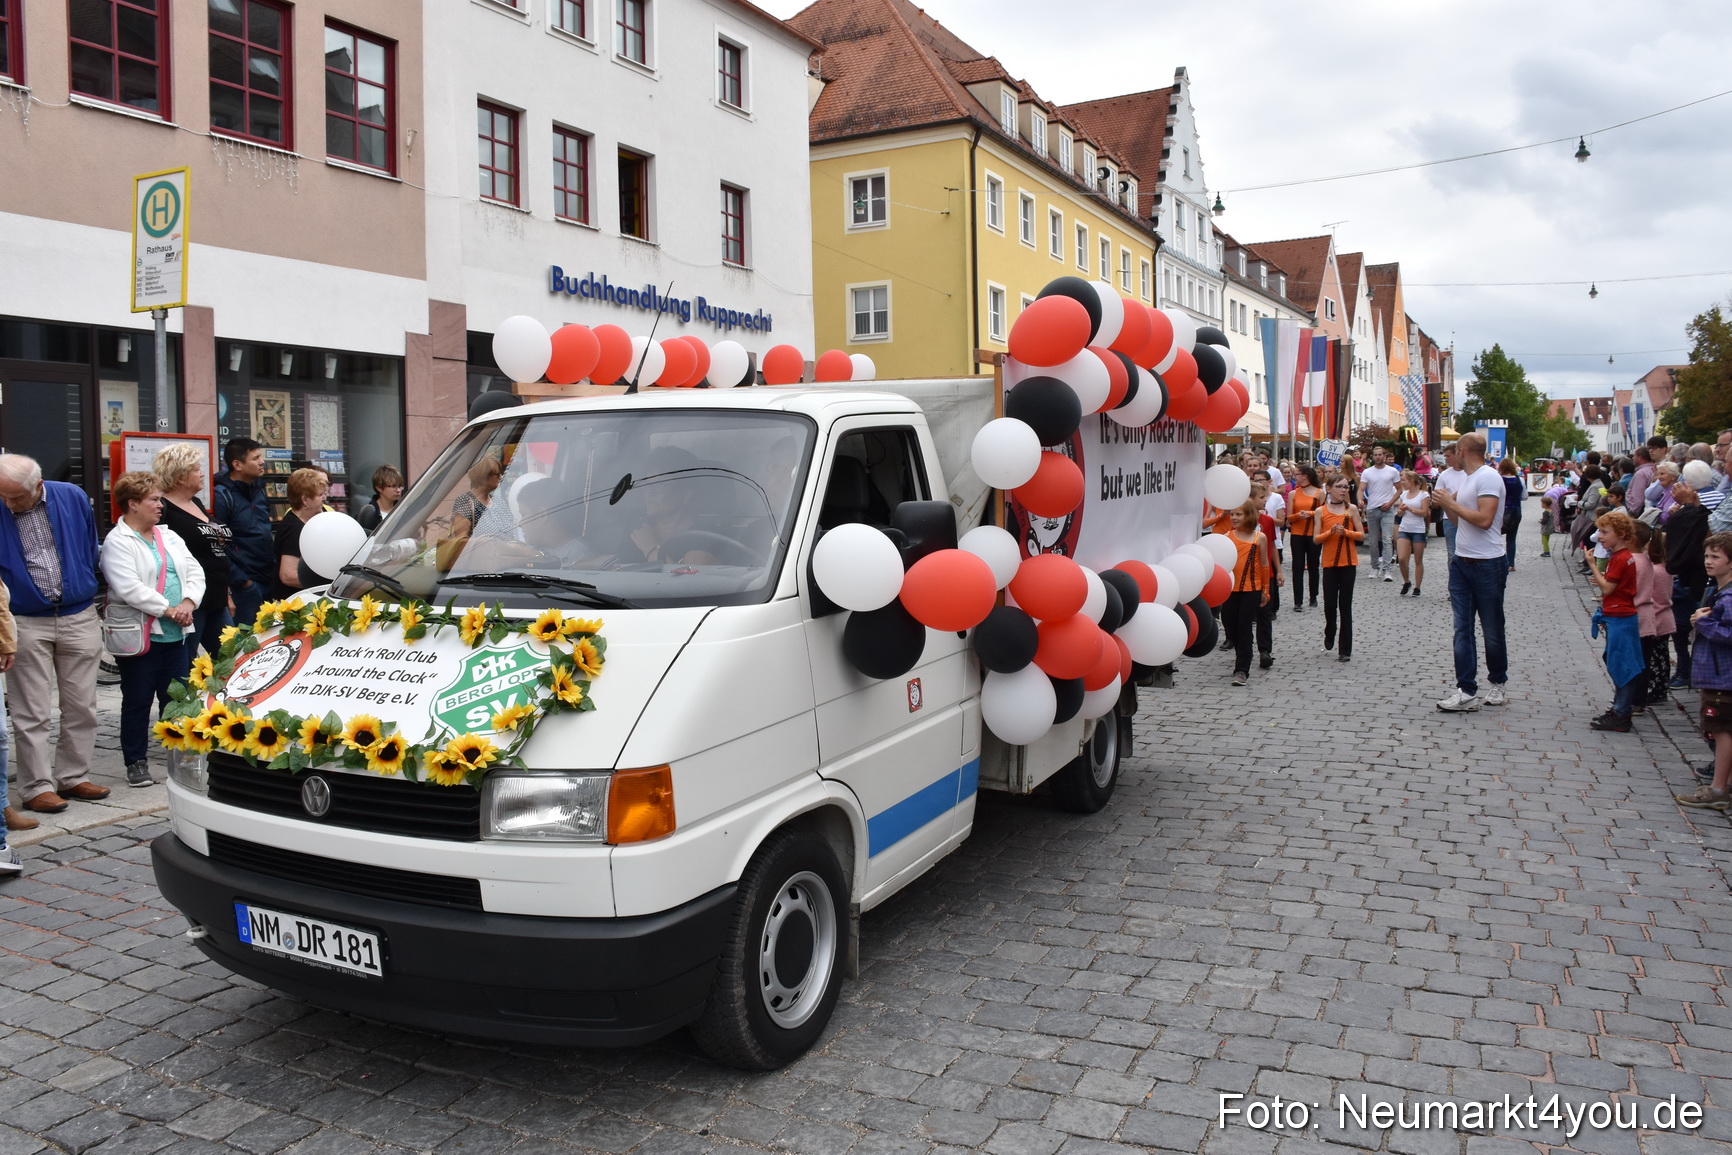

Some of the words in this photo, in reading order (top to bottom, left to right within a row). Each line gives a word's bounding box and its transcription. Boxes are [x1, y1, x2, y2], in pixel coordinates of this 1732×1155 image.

[146, 244, 173, 255] Rathaus
[550, 265, 691, 323] Buchhandlung
[696, 296, 773, 333] Rupprecht
[1440, 391, 1449, 427] HOTE
[1321, 451, 1341, 462] STAUF
[1328, 444, 1338, 453] SV
[1100, 464, 1123, 502] but
[1126, 471, 1141, 498] we
[1143, 461, 1163, 495] like
[1164, 461, 1177, 492] it!
[405, 650, 438, 664] Club
[471, 652, 518, 683] DJK
[361, 667, 387, 680] the
[290, 683, 309, 695] im
[309, 684, 359, 699] DJK-SV
[356, 687, 391, 705] Berg
[390, 693, 419, 706] e.V.
[445, 684, 494, 709] BERG
[465, 692, 518, 729] SV
[242, 926, 248, 936] D
[249, 910, 281, 946] NM
[295, 920, 328, 958] DR
[332, 929, 378, 971] 181
